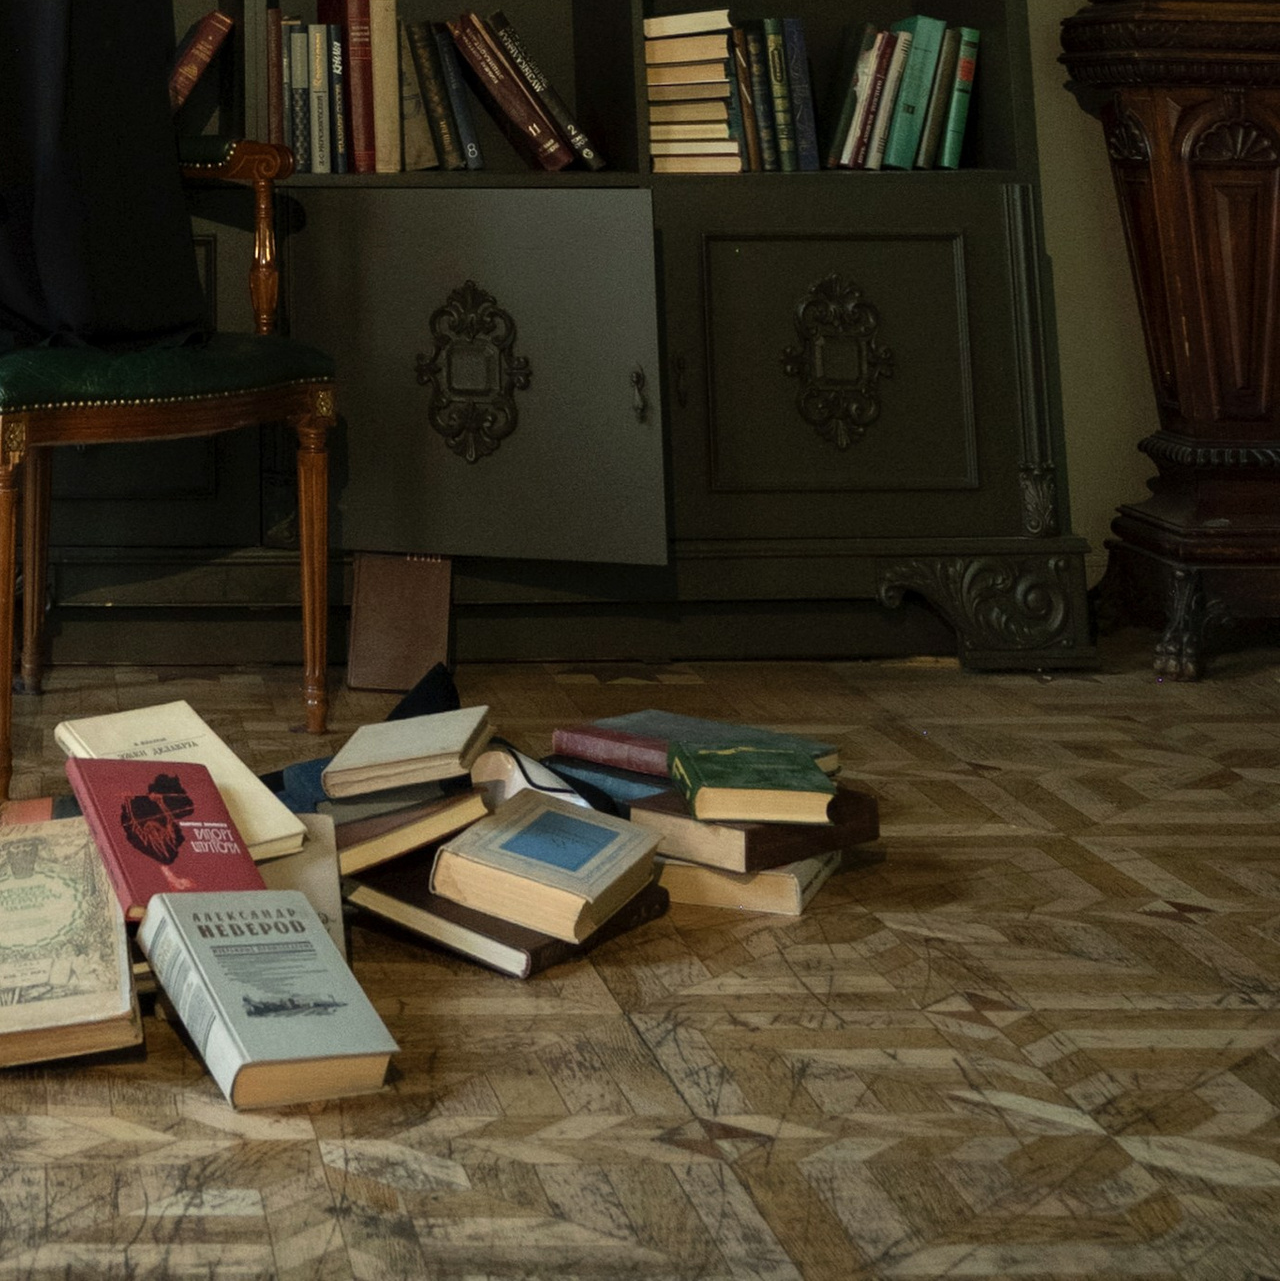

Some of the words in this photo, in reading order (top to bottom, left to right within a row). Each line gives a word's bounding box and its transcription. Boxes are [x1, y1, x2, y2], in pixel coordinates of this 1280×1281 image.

[567, 123, 578, 135] 2
[466, 142, 479, 158] 8
[192, 908, 296, 922] АЛЕКСАНДР
[196, 920, 306, 938] НЕВЕРОВ
